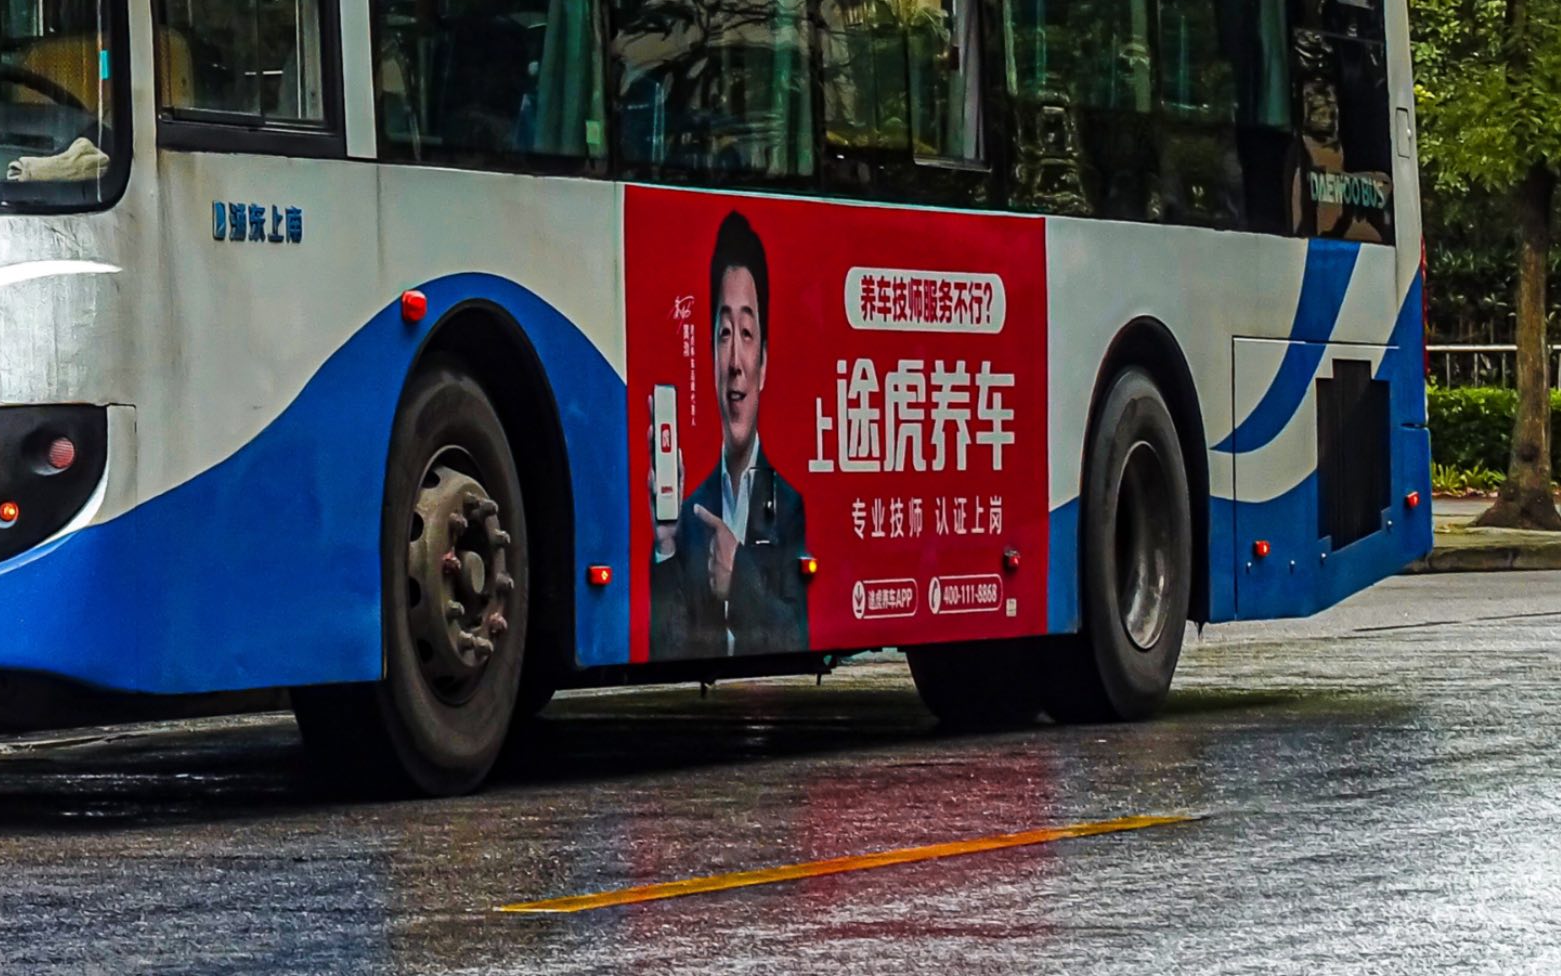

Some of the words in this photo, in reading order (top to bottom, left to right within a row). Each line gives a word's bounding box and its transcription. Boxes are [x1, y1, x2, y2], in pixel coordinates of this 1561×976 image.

[851, 498, 924, 539] 专业技师
[935, 496, 1002, 535] 认证上岗
